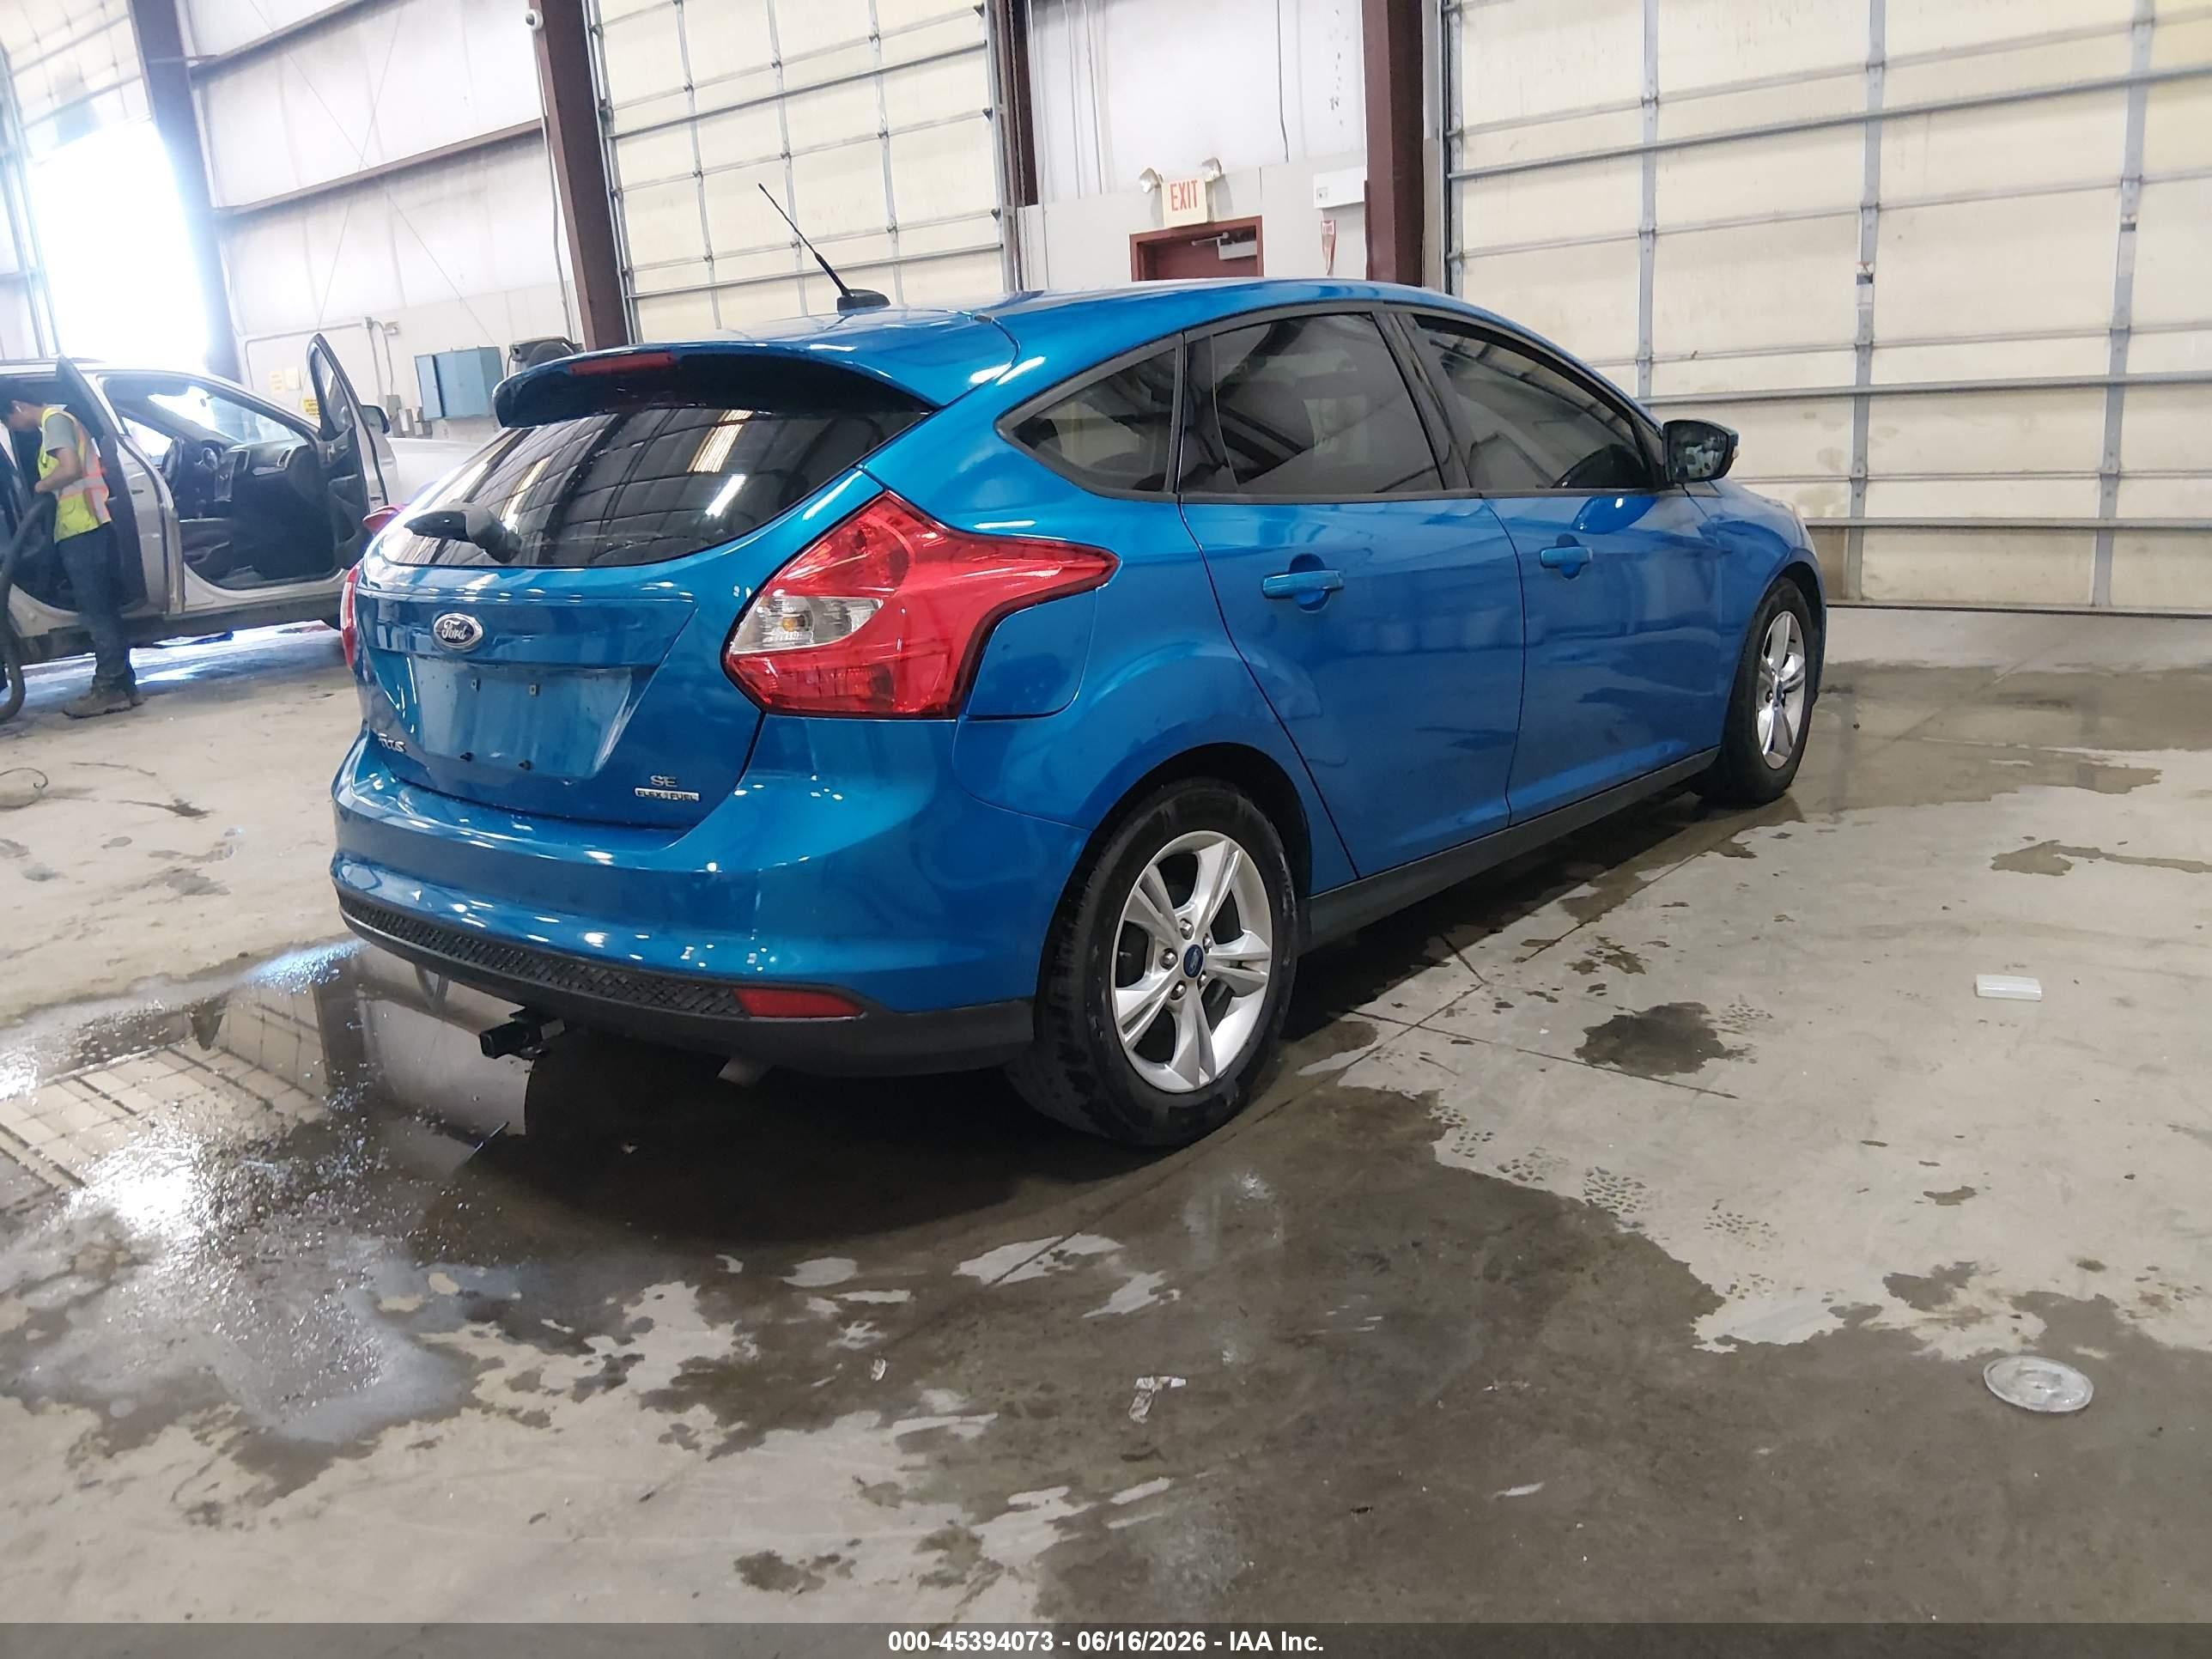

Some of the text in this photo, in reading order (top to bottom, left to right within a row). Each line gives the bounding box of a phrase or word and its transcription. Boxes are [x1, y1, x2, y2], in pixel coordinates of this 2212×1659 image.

[1170, 179, 1198, 212] EXIT
[441, 619, 468, 640] Ford
[650, 775, 678, 787] SE
